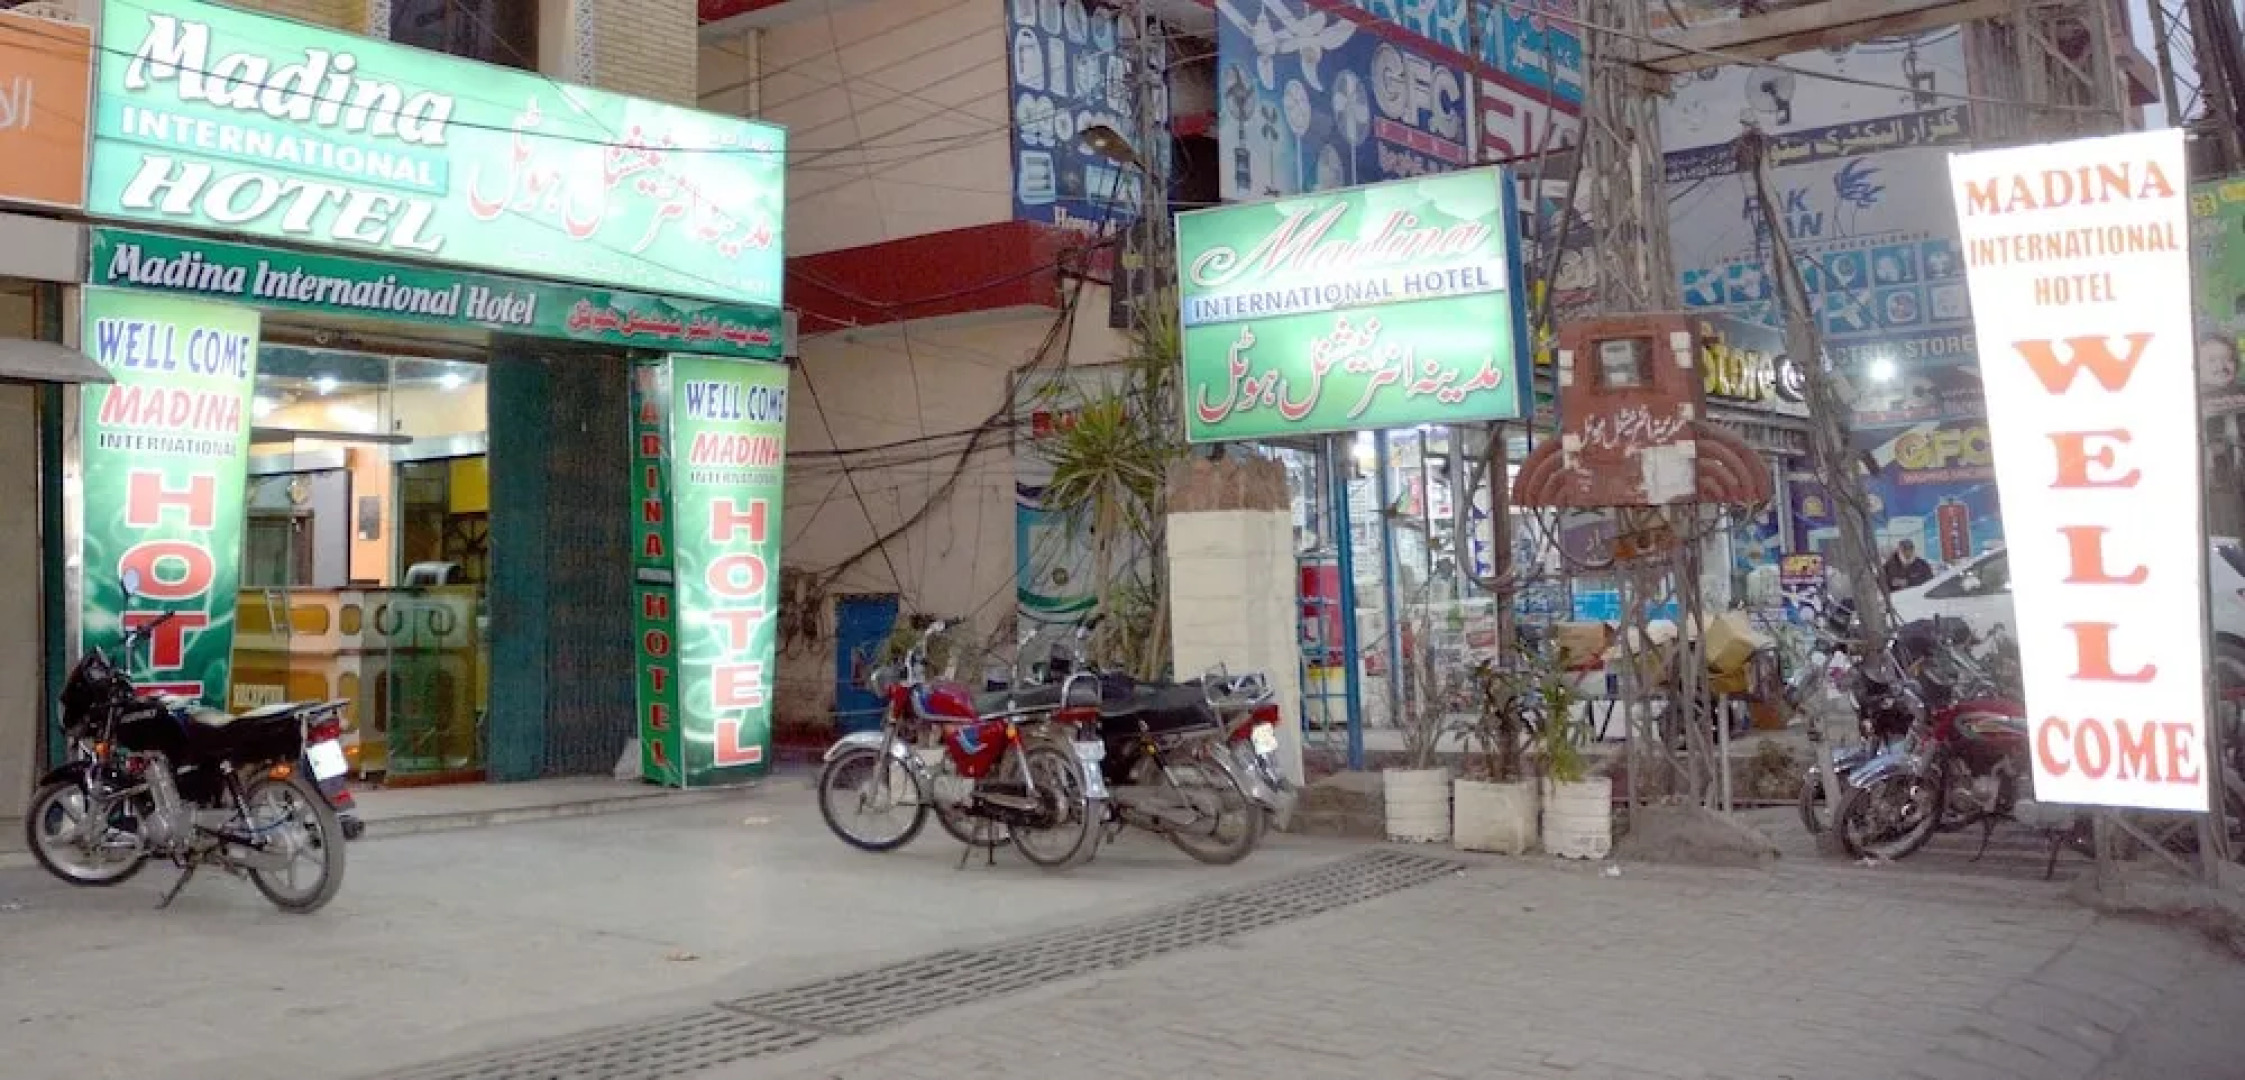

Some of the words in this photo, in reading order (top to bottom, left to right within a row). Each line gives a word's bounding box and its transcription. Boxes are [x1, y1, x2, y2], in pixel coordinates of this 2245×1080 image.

[124, 13, 453, 146] Madina
[1372, 43, 1460, 143] GFC
[120, 106, 436, 186] INTERNATIONAL
[120, 153, 445, 253] HOTEL
[1742, 185, 1808, 220] PK
[1964, 158, 2176, 217] MADINA
[1190, 202, 1492, 287] Madina
[1969, 221, 2180, 268] INTERNATIONAL
[108, 242, 246, 294] Madina
[254, 258, 460, 318] International
[465, 286, 537, 325] Hotel
[1194, 278, 1393, 319] INTERNATIONAL
[1404, 266, 1490, 294] HOTEL
[2034, 271, 2117, 306] HOTEL
[98, 320, 176, 372] WELL
[187, 327, 250, 379] COME
[1197, 324, 1281, 423] ہوٹل
[1904, 334, 1976, 358] STORE
[99, 384, 242, 433] MADINA
[685, 382, 742, 419] WELL
[747, 385, 785, 423] COME
[99, 432, 237, 457] INTERNATIONAL
[690, 431, 780, 465] MADINA
[1894, 428, 1994, 471] GFC
[2011, 332, 2159, 683] WELL
[705, 498, 770, 768] HOTEL
[643, 594, 670, 769] HOTEL
[2036, 716, 2200, 786] COME
